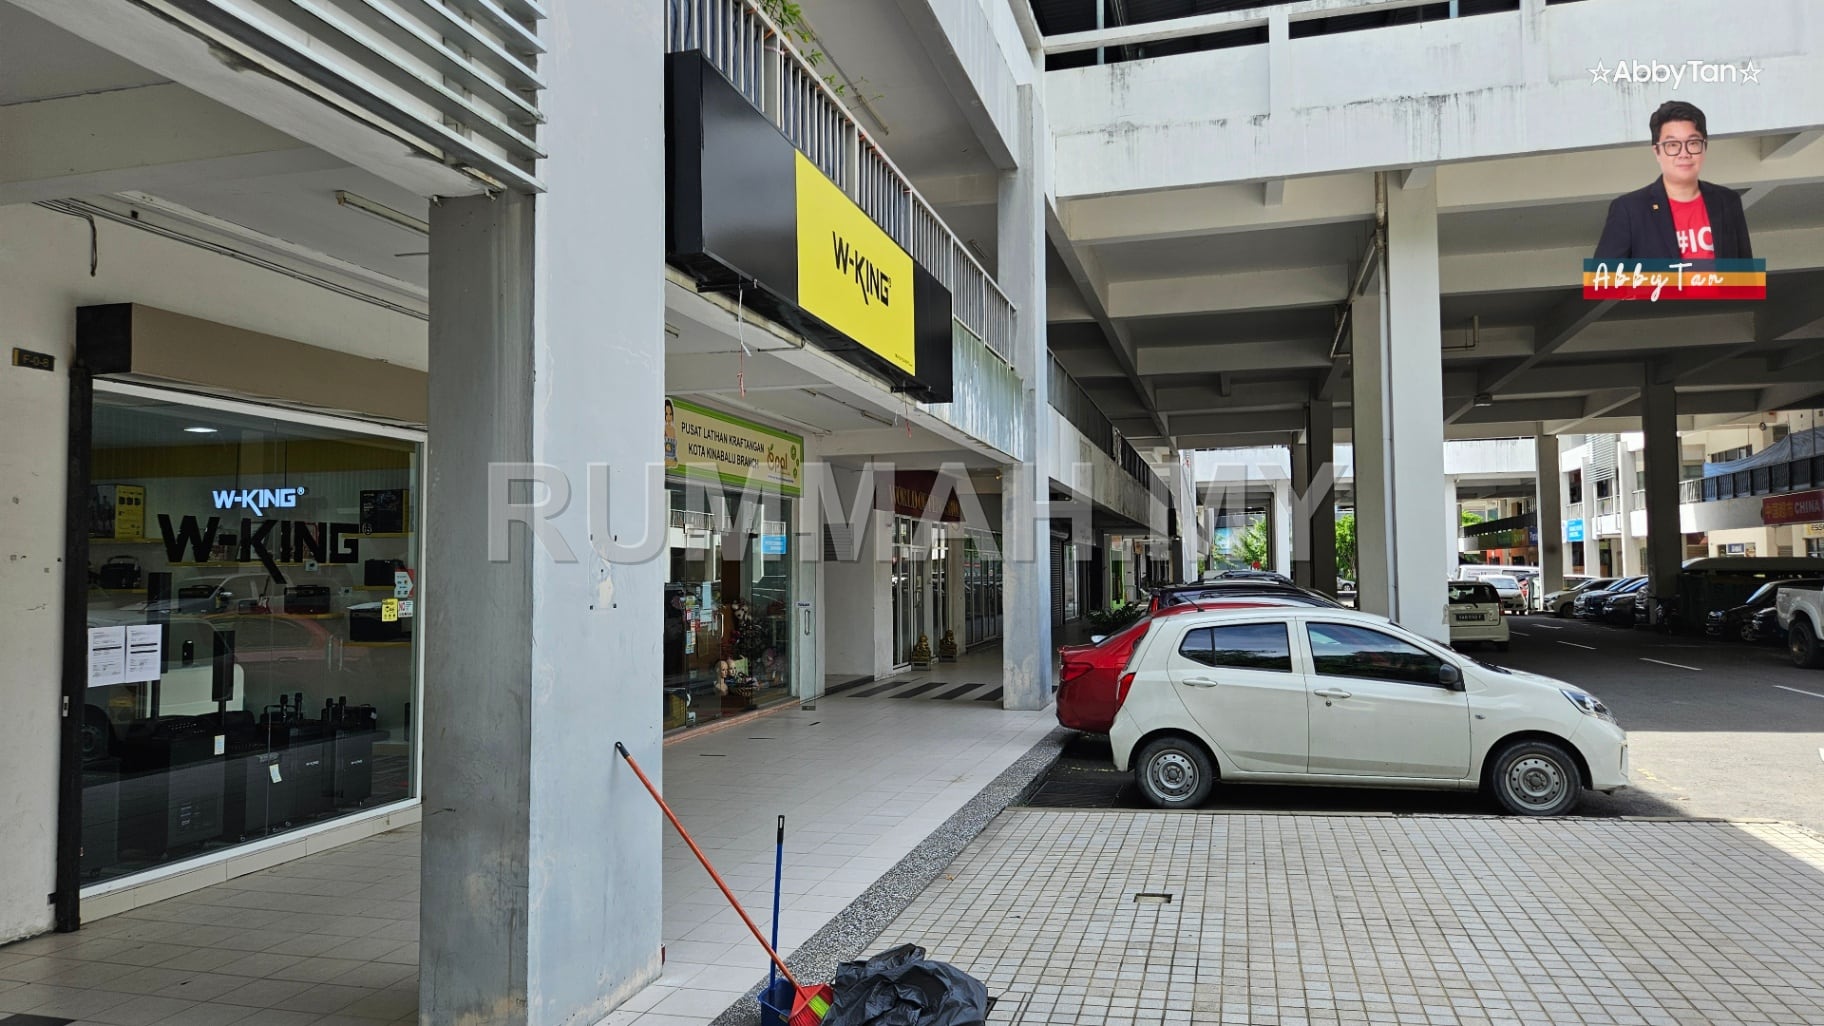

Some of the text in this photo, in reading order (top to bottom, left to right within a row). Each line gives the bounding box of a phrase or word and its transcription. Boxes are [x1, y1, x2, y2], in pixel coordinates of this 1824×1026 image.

[681, 421, 765, 453] PUSAT LATIHAN KRAFTANGAN
[688, 443, 760, 470] KOTA KINABALU BRANCH
